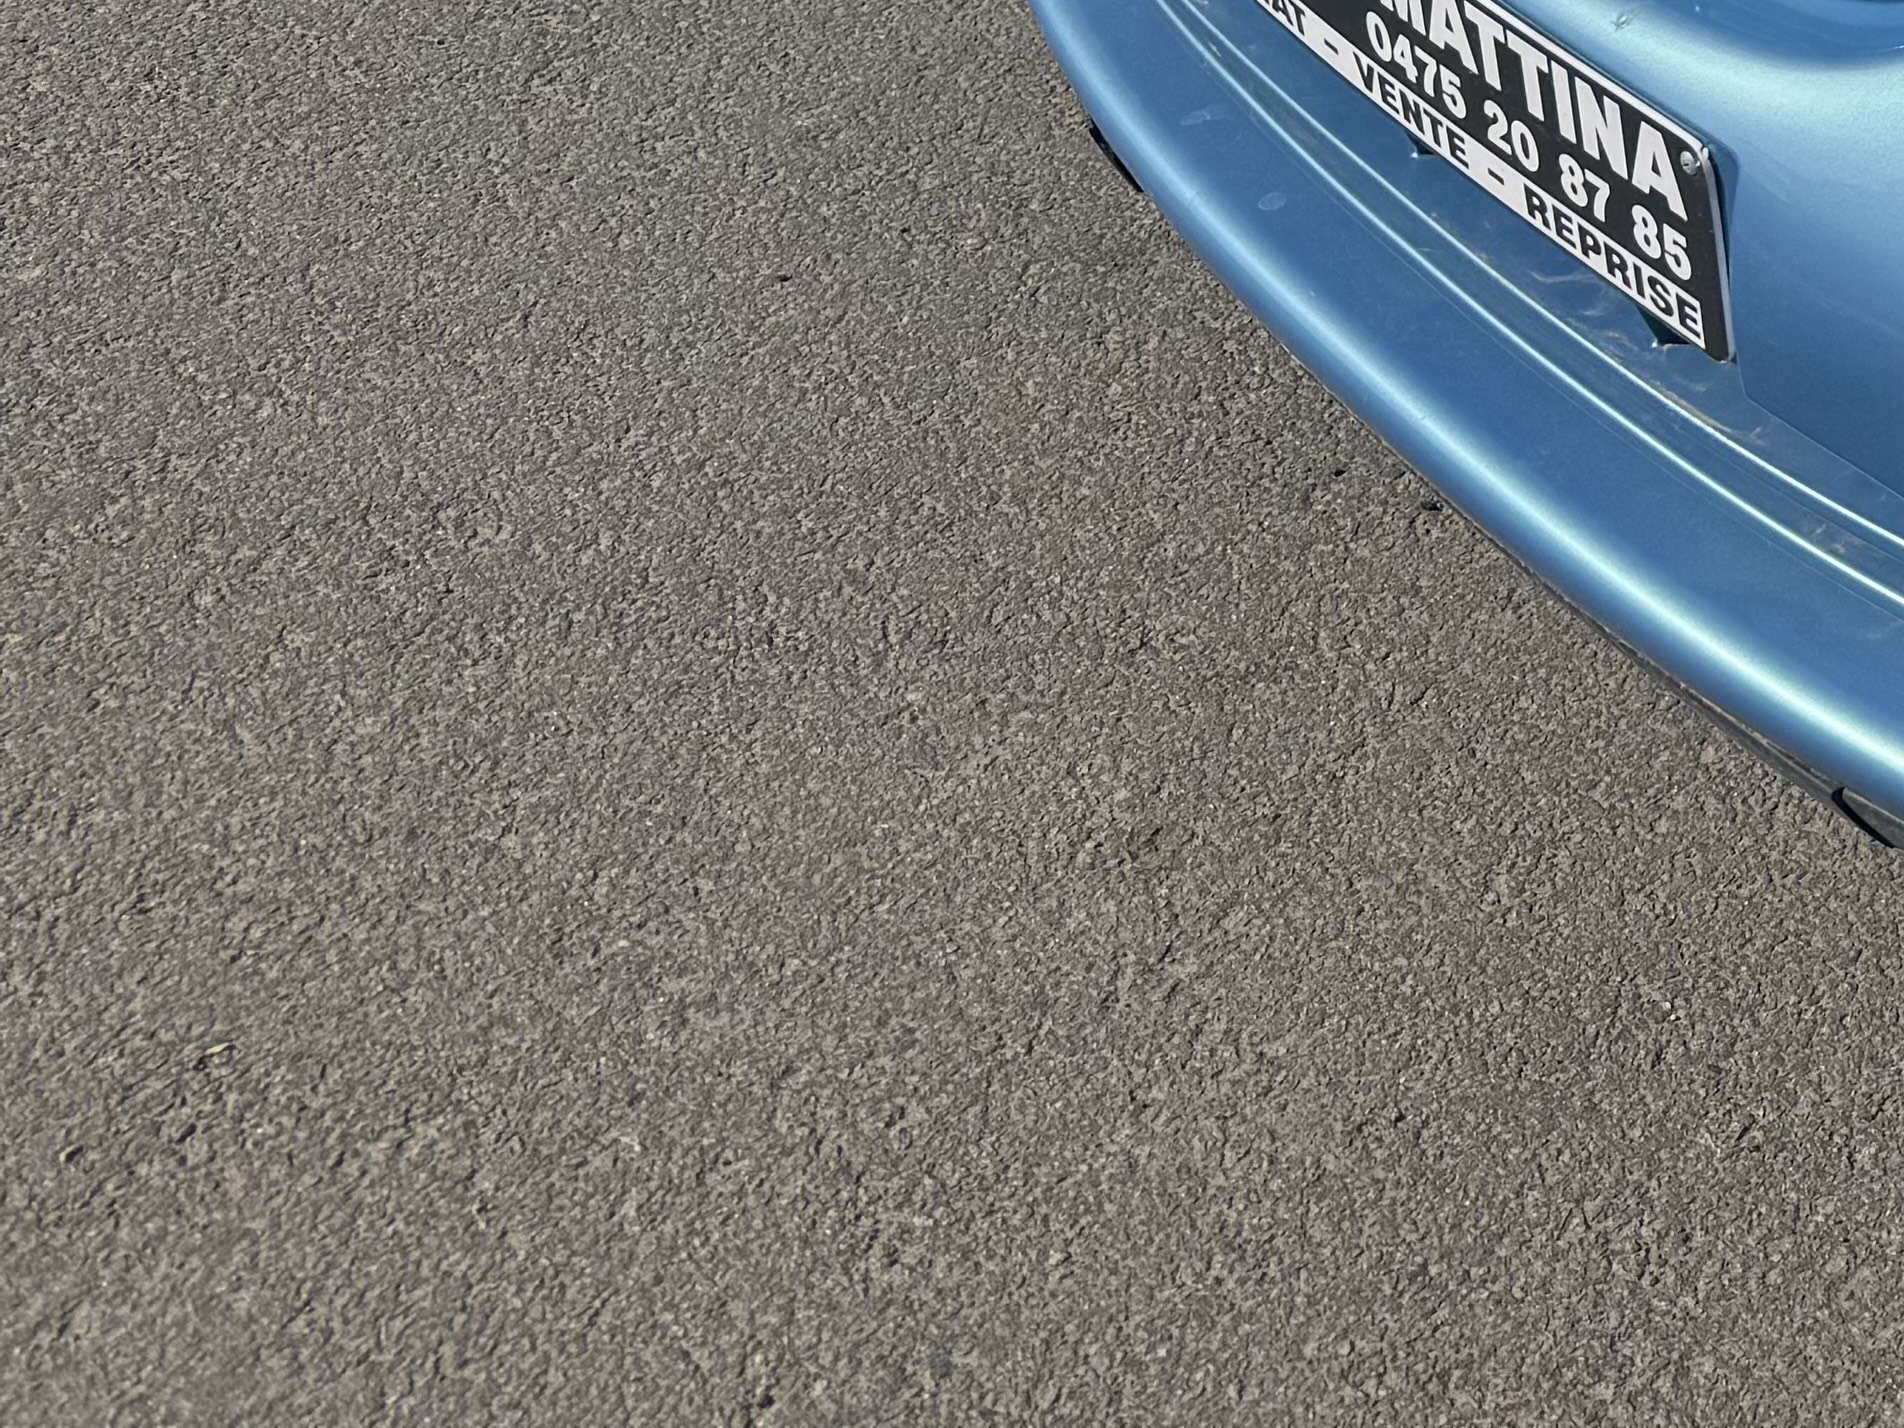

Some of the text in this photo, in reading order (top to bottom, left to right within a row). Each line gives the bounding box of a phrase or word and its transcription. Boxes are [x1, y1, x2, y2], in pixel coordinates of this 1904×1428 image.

[1352, 53, 1470, 170] VENTE
[1524, 188, 1700, 333] REPRISE
[1366, 11, 1692, 280] 0475 20 87 85
